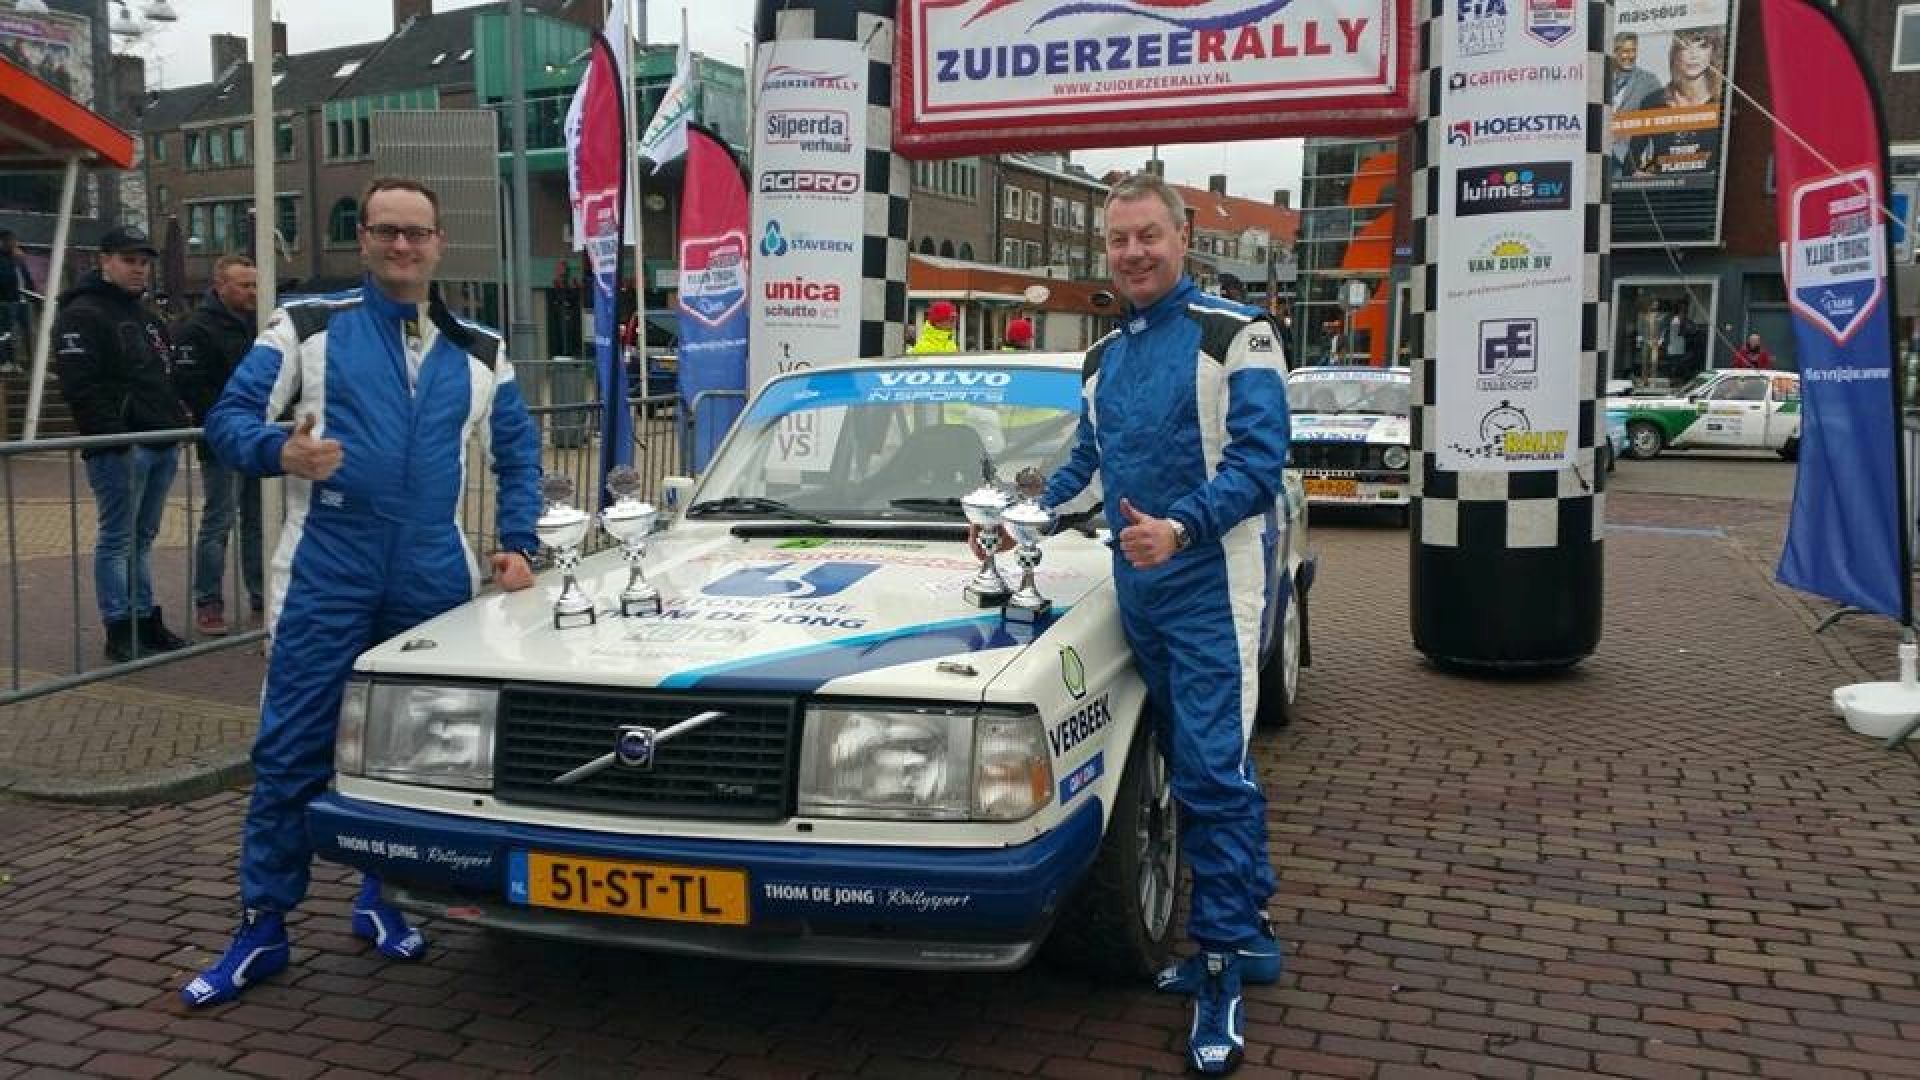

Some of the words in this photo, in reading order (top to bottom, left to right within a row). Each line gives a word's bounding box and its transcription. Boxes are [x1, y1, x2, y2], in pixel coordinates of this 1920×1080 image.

[936, 18, 1369, 83] ZUIDERZEERALLY
[1053, 71, 1233, 95] WWW.ZUIDERZEERALLY.NL
[1469, 63, 1584, 87] cameranu.nl
[768, 113, 843, 139] Sijperda
[1473, 114, 1582, 135] HOEKSTRA
[801, 139, 853, 152] verhuur
[760, 172, 858, 192] AGPRO
[1463, 179, 1535, 201] luimes
[790, 239, 854, 252] STAVEREN
[1469, 258, 1495, 273] VAN
[764, 275, 841, 302] unica
[764, 304, 817, 318] schutte
[878, 370, 1012, 387] VOLVO
[704, 610, 756, 621] DE
[764, 612, 868, 629] JONG
[1048, 692, 1113, 758] VERBEEK
[337, 834, 369, 852] THOM
[371, 839, 386, 855] DE
[387, 841, 419, 859] JONG
[511, 881, 528, 895] NL
[550, 864, 722, 916] 51-ST-TL
[764, 884, 809, 900] THOM
[811, 887, 831, 902] DE
[833, 888, 875, 906] JONG
